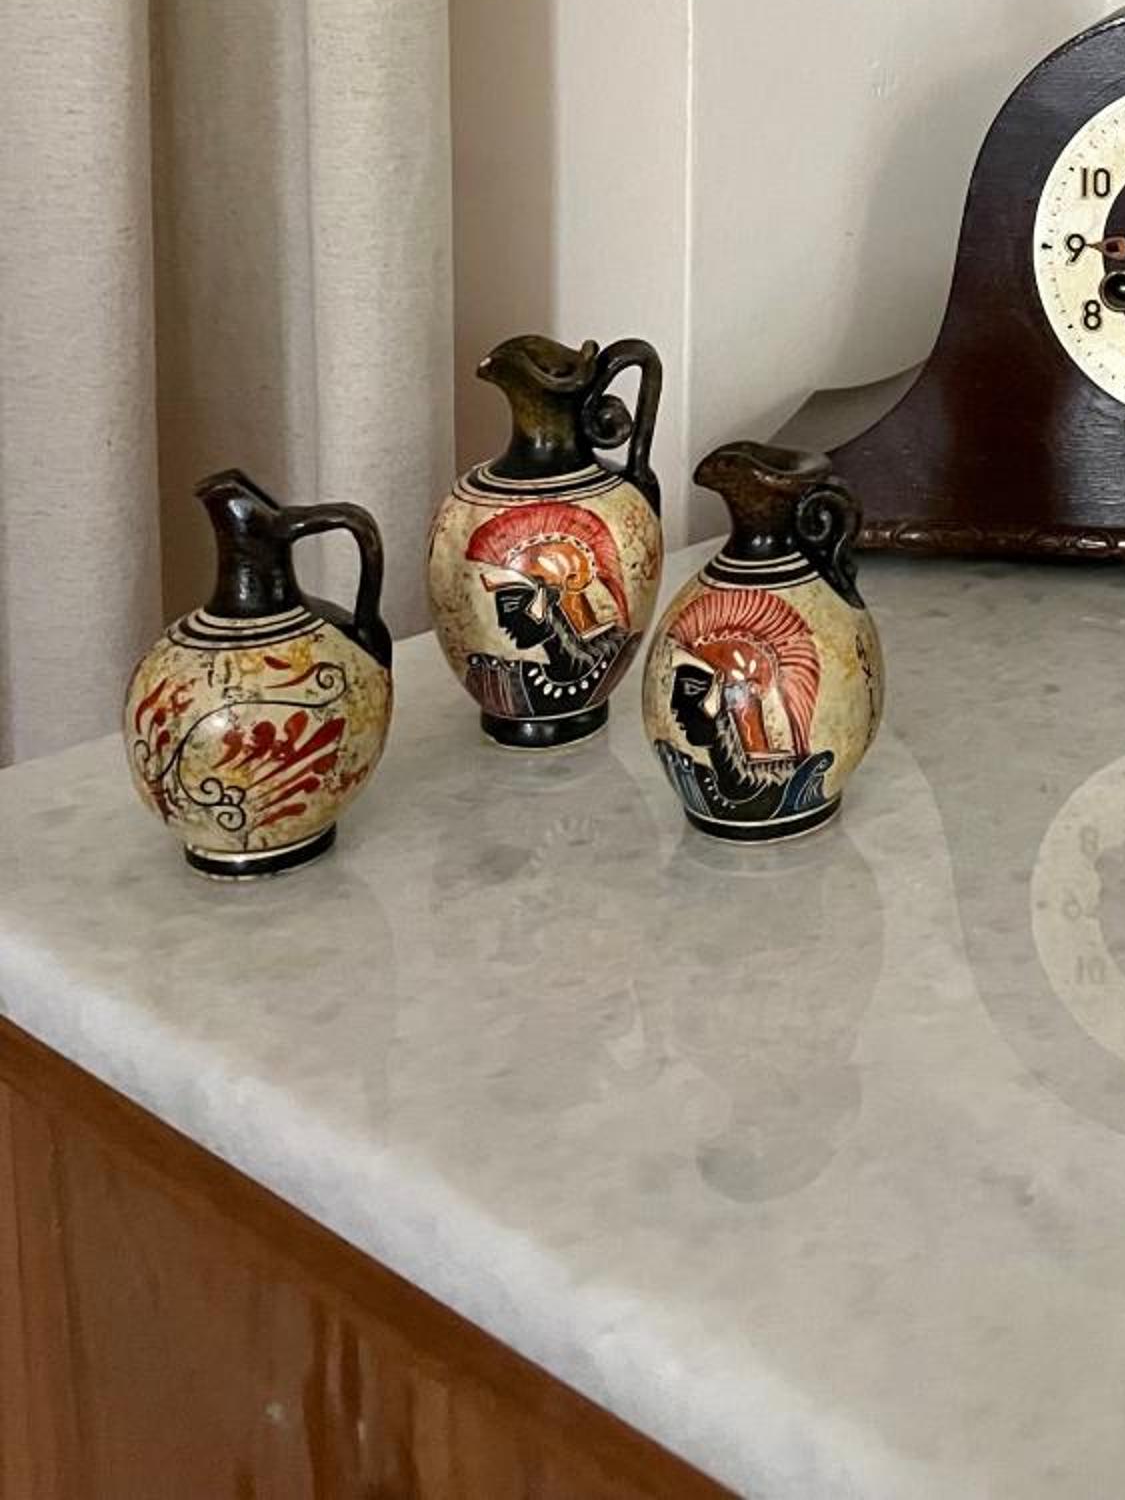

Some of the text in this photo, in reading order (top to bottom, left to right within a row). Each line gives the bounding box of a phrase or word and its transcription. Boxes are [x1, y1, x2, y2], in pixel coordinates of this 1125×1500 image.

[1082, 168, 1110, 197] 10
[1066, 234, 1086, 263] 9
[1083, 299, 1102, 331] 8
